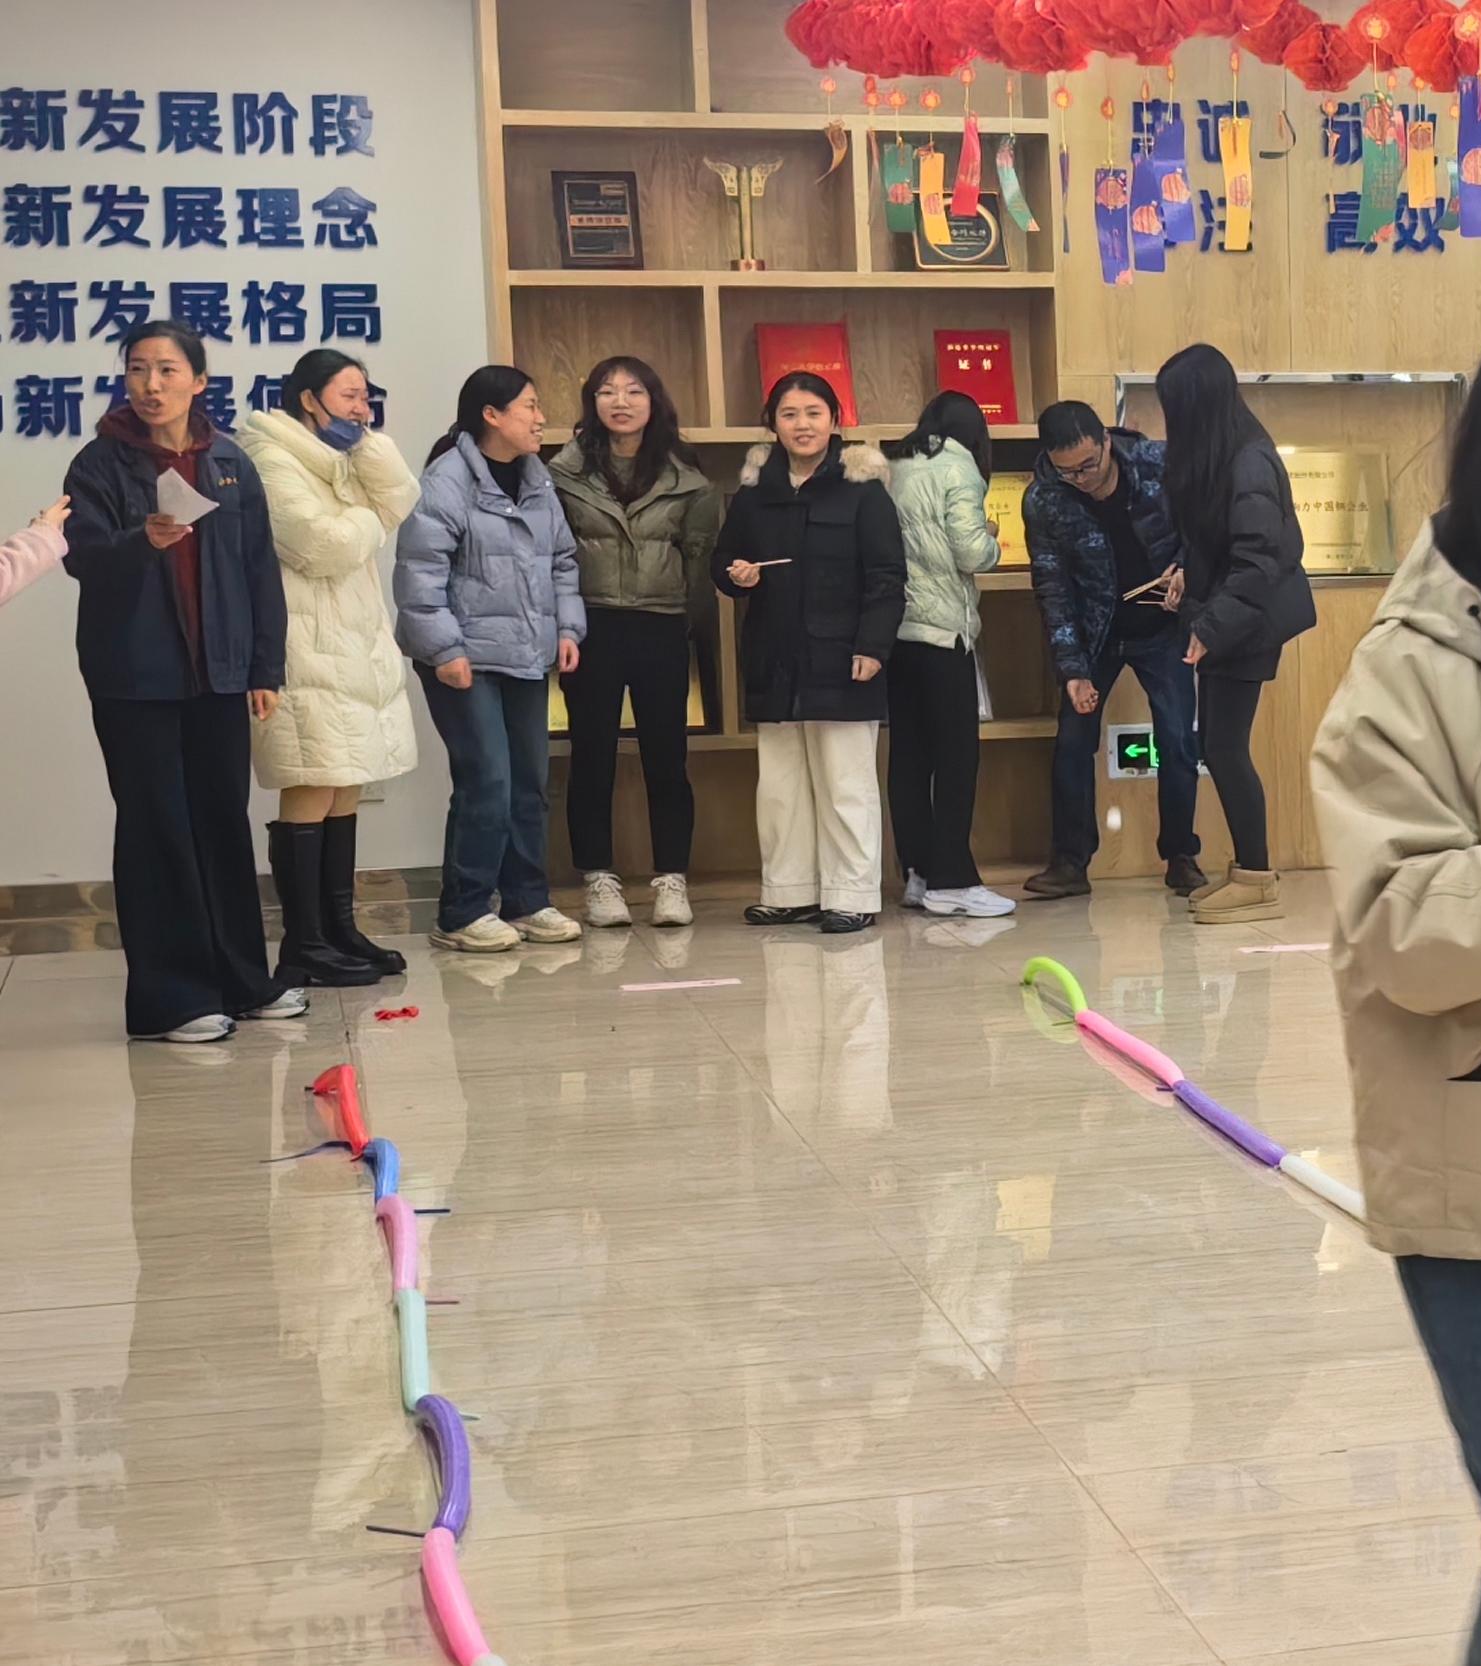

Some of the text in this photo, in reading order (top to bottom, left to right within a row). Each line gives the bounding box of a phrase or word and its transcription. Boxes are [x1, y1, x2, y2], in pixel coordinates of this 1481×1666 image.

[0, 87, 375, 157] 新发展阶段
[3, 183, 379, 249] 新发展理念
[9, 279, 382, 345] 新发展格局
